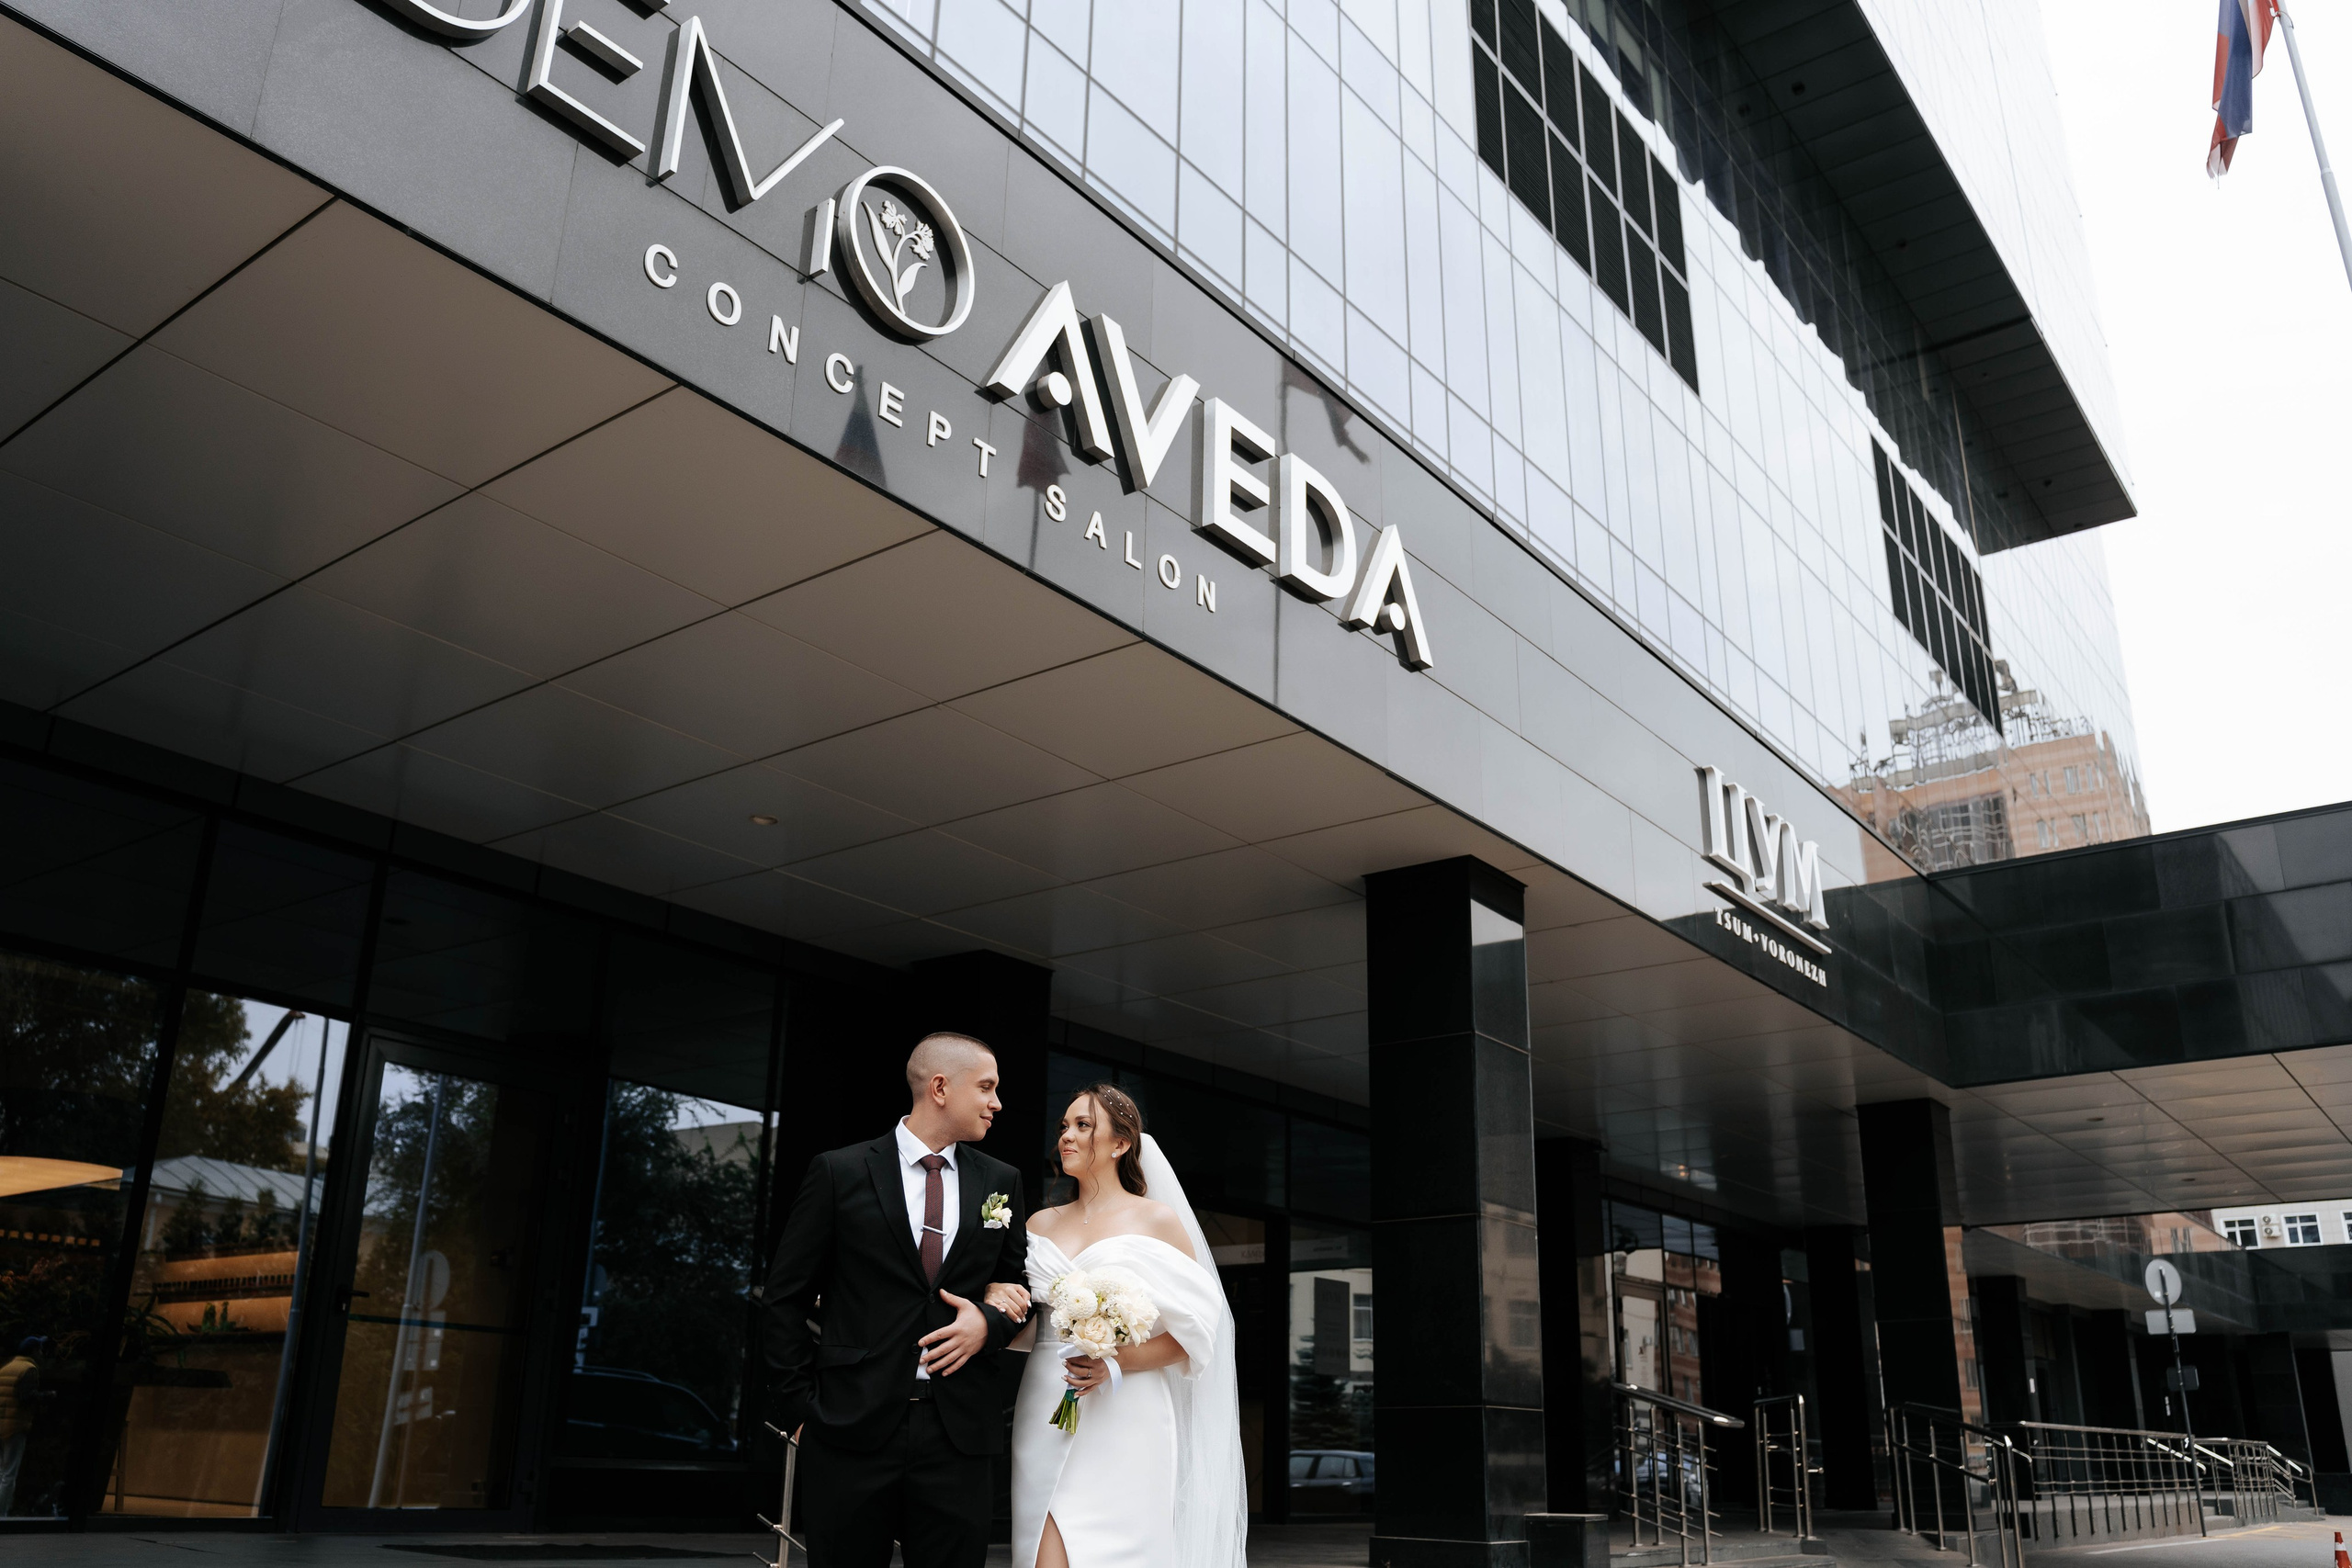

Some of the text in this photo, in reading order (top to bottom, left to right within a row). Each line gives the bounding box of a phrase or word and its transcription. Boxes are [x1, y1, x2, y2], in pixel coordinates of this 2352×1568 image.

[644, 243, 997, 479] CONCEPT
[986, 279, 1433, 670] AVEDA
[1045, 484, 1216, 613] SALON
[1702, 764, 1830, 930] ЦУМ
